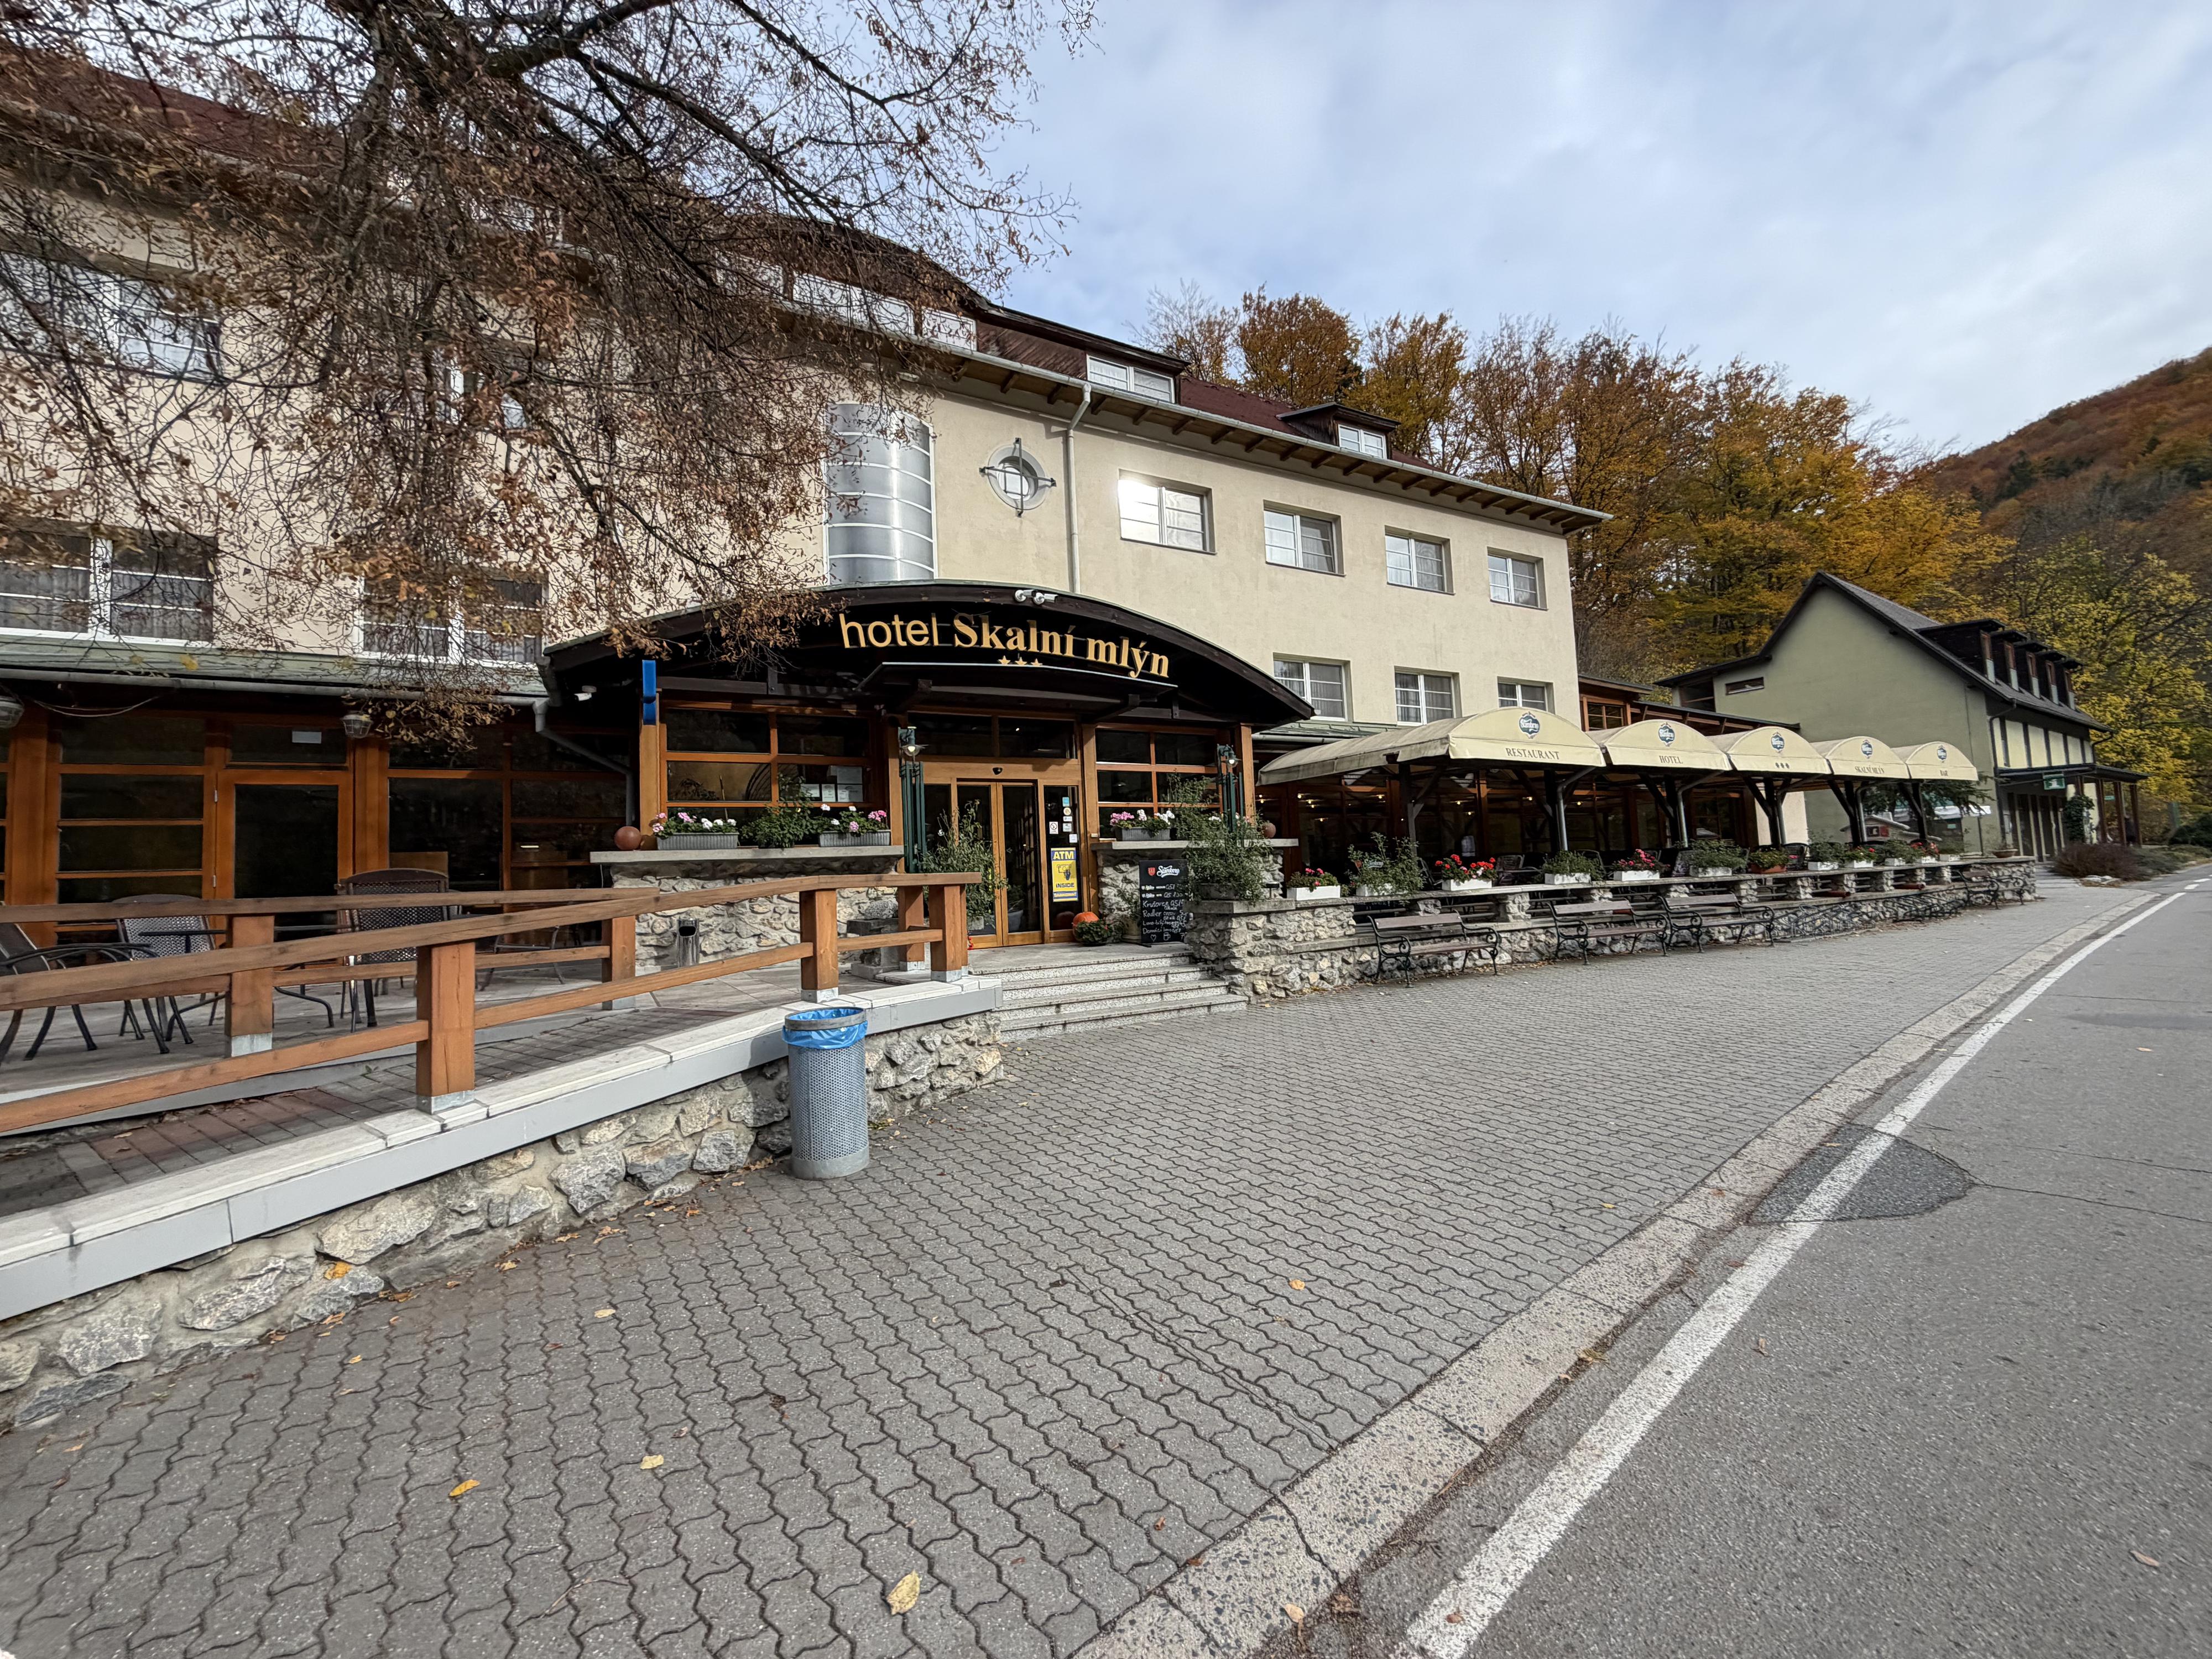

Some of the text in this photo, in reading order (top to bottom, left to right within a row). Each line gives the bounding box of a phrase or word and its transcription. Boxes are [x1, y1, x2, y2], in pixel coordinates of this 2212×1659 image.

[839, 612, 1169, 679] hotel Skalní mlýn
[1505, 748, 1559, 760] RESTAURANT
[1659, 755, 1683, 764] HOTEL
[1053, 851, 1074, 860] ATM
[1142, 909, 1162, 917] Radler
